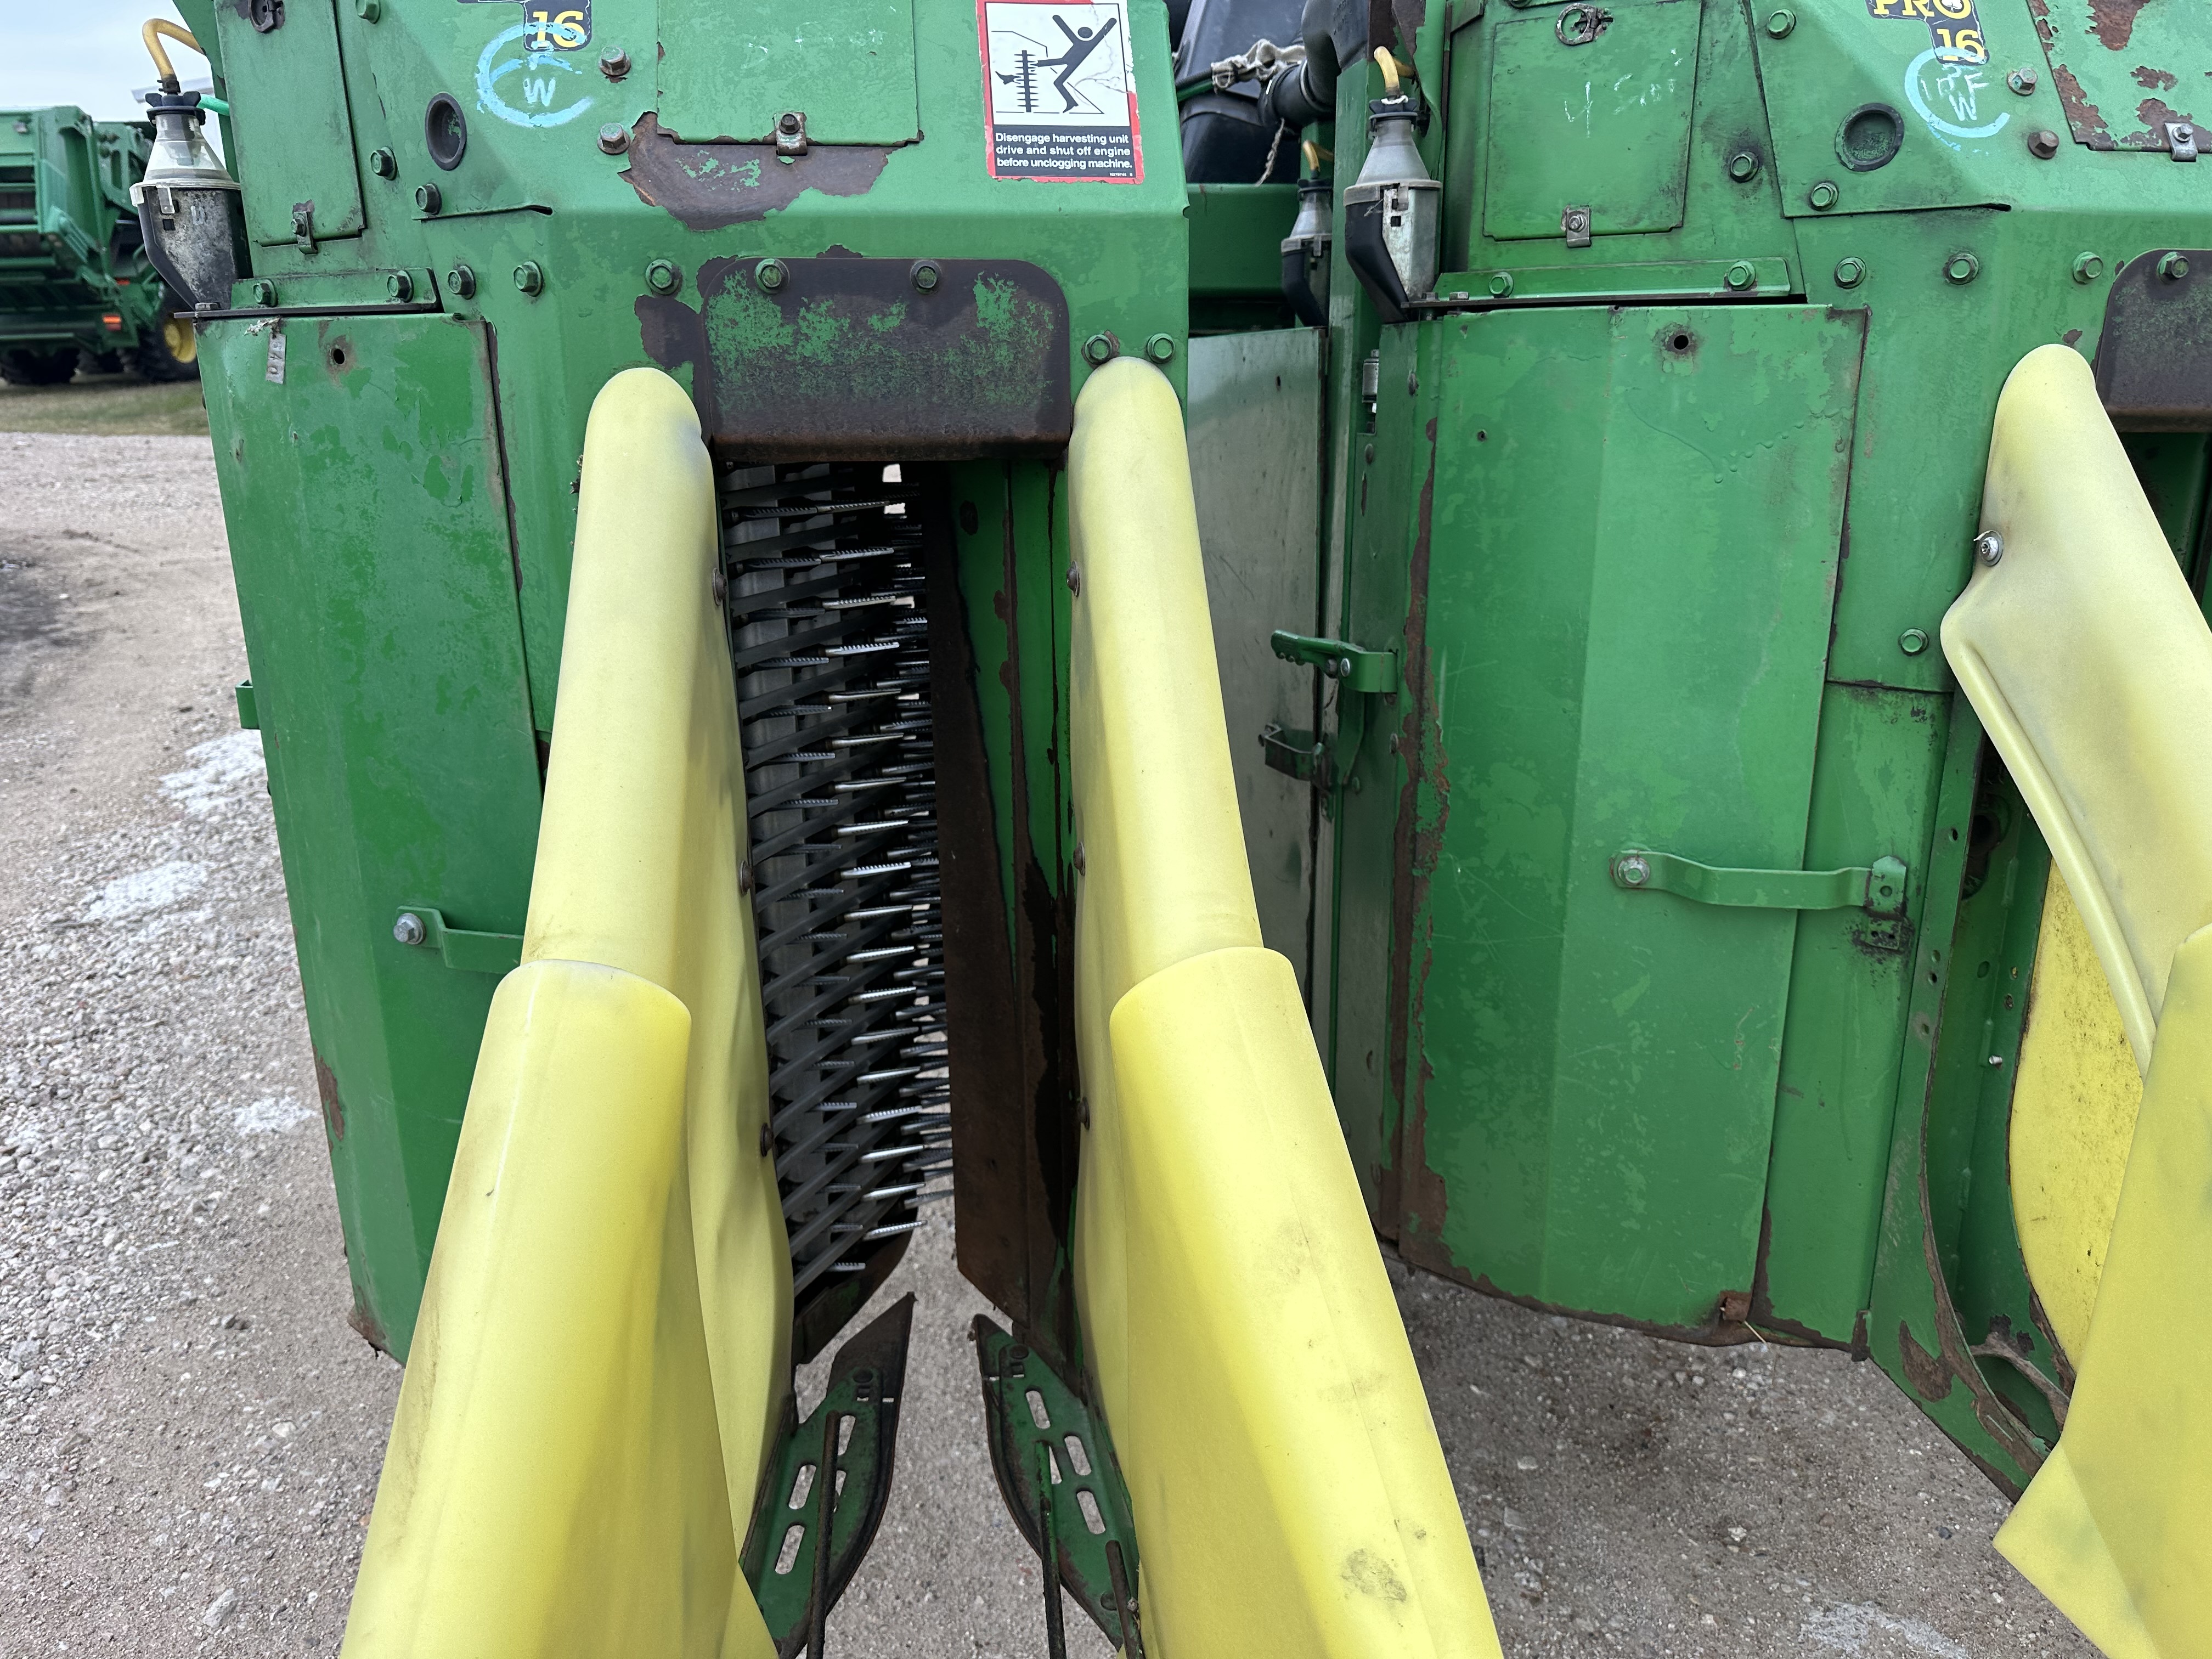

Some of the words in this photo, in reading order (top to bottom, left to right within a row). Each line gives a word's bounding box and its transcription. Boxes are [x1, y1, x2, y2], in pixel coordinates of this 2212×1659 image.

[533, 10, 585, 48] 16
[1937, 29, 1985, 63] 16
[995, 133, 1050, 144] Disengage
[1053, 133, 1107, 145] harvesting
[1109, 134, 1129, 144] unit
[996, 145, 1023, 155] drive
[1026, 146, 1047, 155] and
[1050, 146, 1074, 155] shut
[1077, 146, 1091, 155] off
[1094, 147, 1131, 157] engine
[997, 157, 1029, 167] before
[1031, 158, 1086, 170] unclogging
[1088, 159, 1133, 168] machine.
